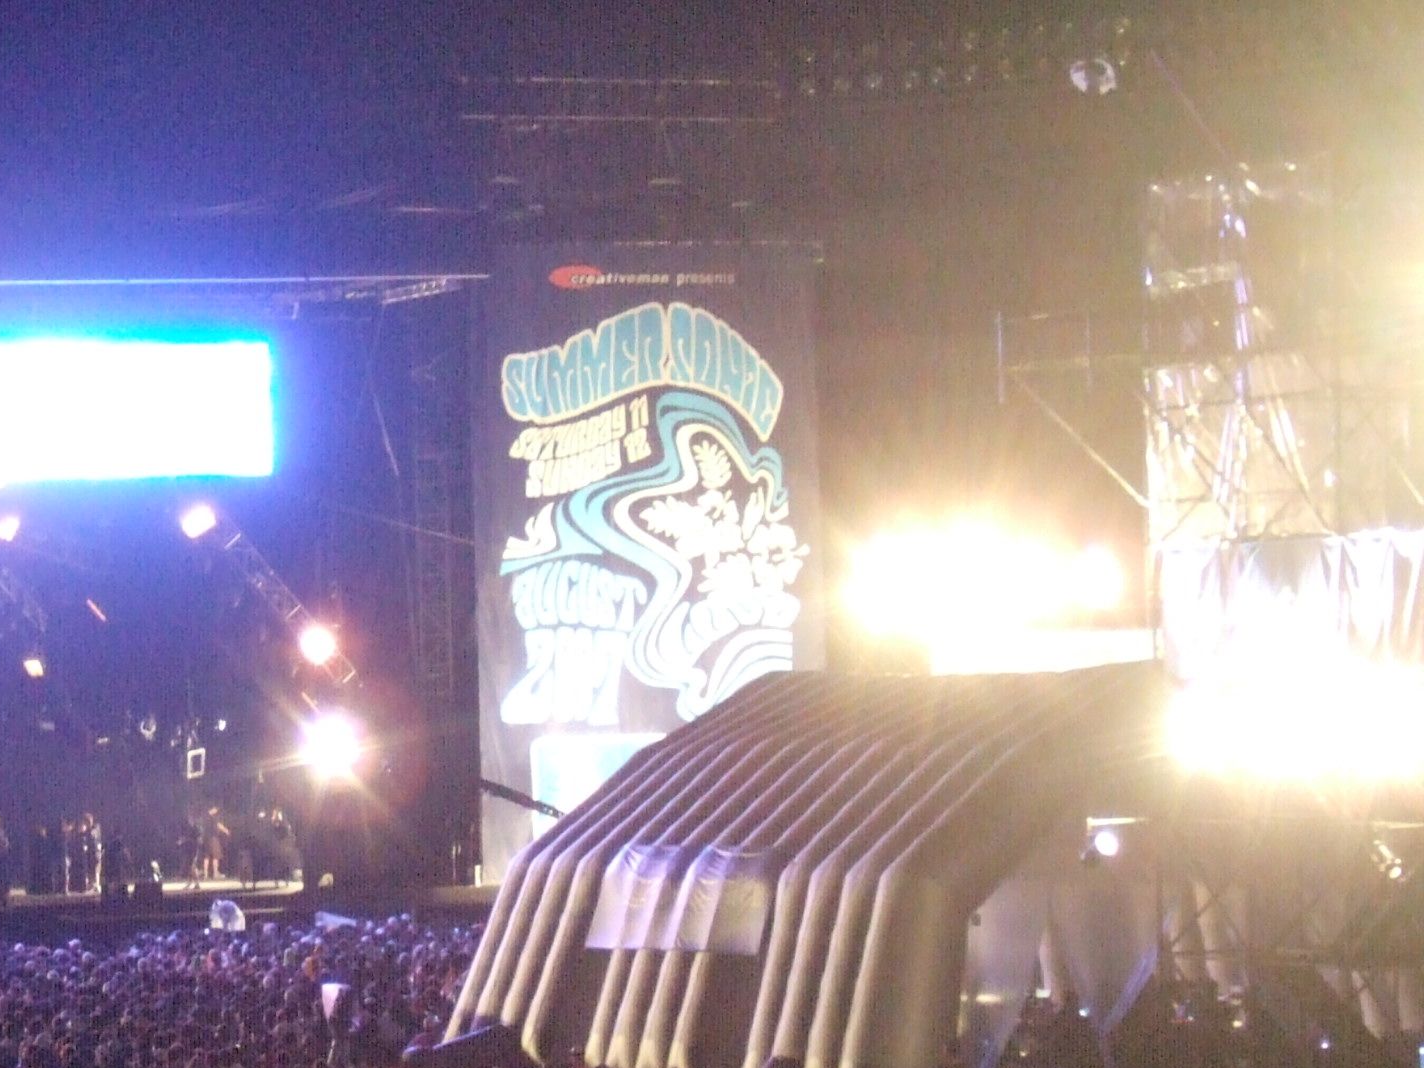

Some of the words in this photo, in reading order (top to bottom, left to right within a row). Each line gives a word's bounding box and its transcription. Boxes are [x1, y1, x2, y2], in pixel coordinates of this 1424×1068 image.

[676, 272, 736, 288] presents
[502, 302, 666, 424] SUMMER
[666, 302, 783, 442] SONIC
